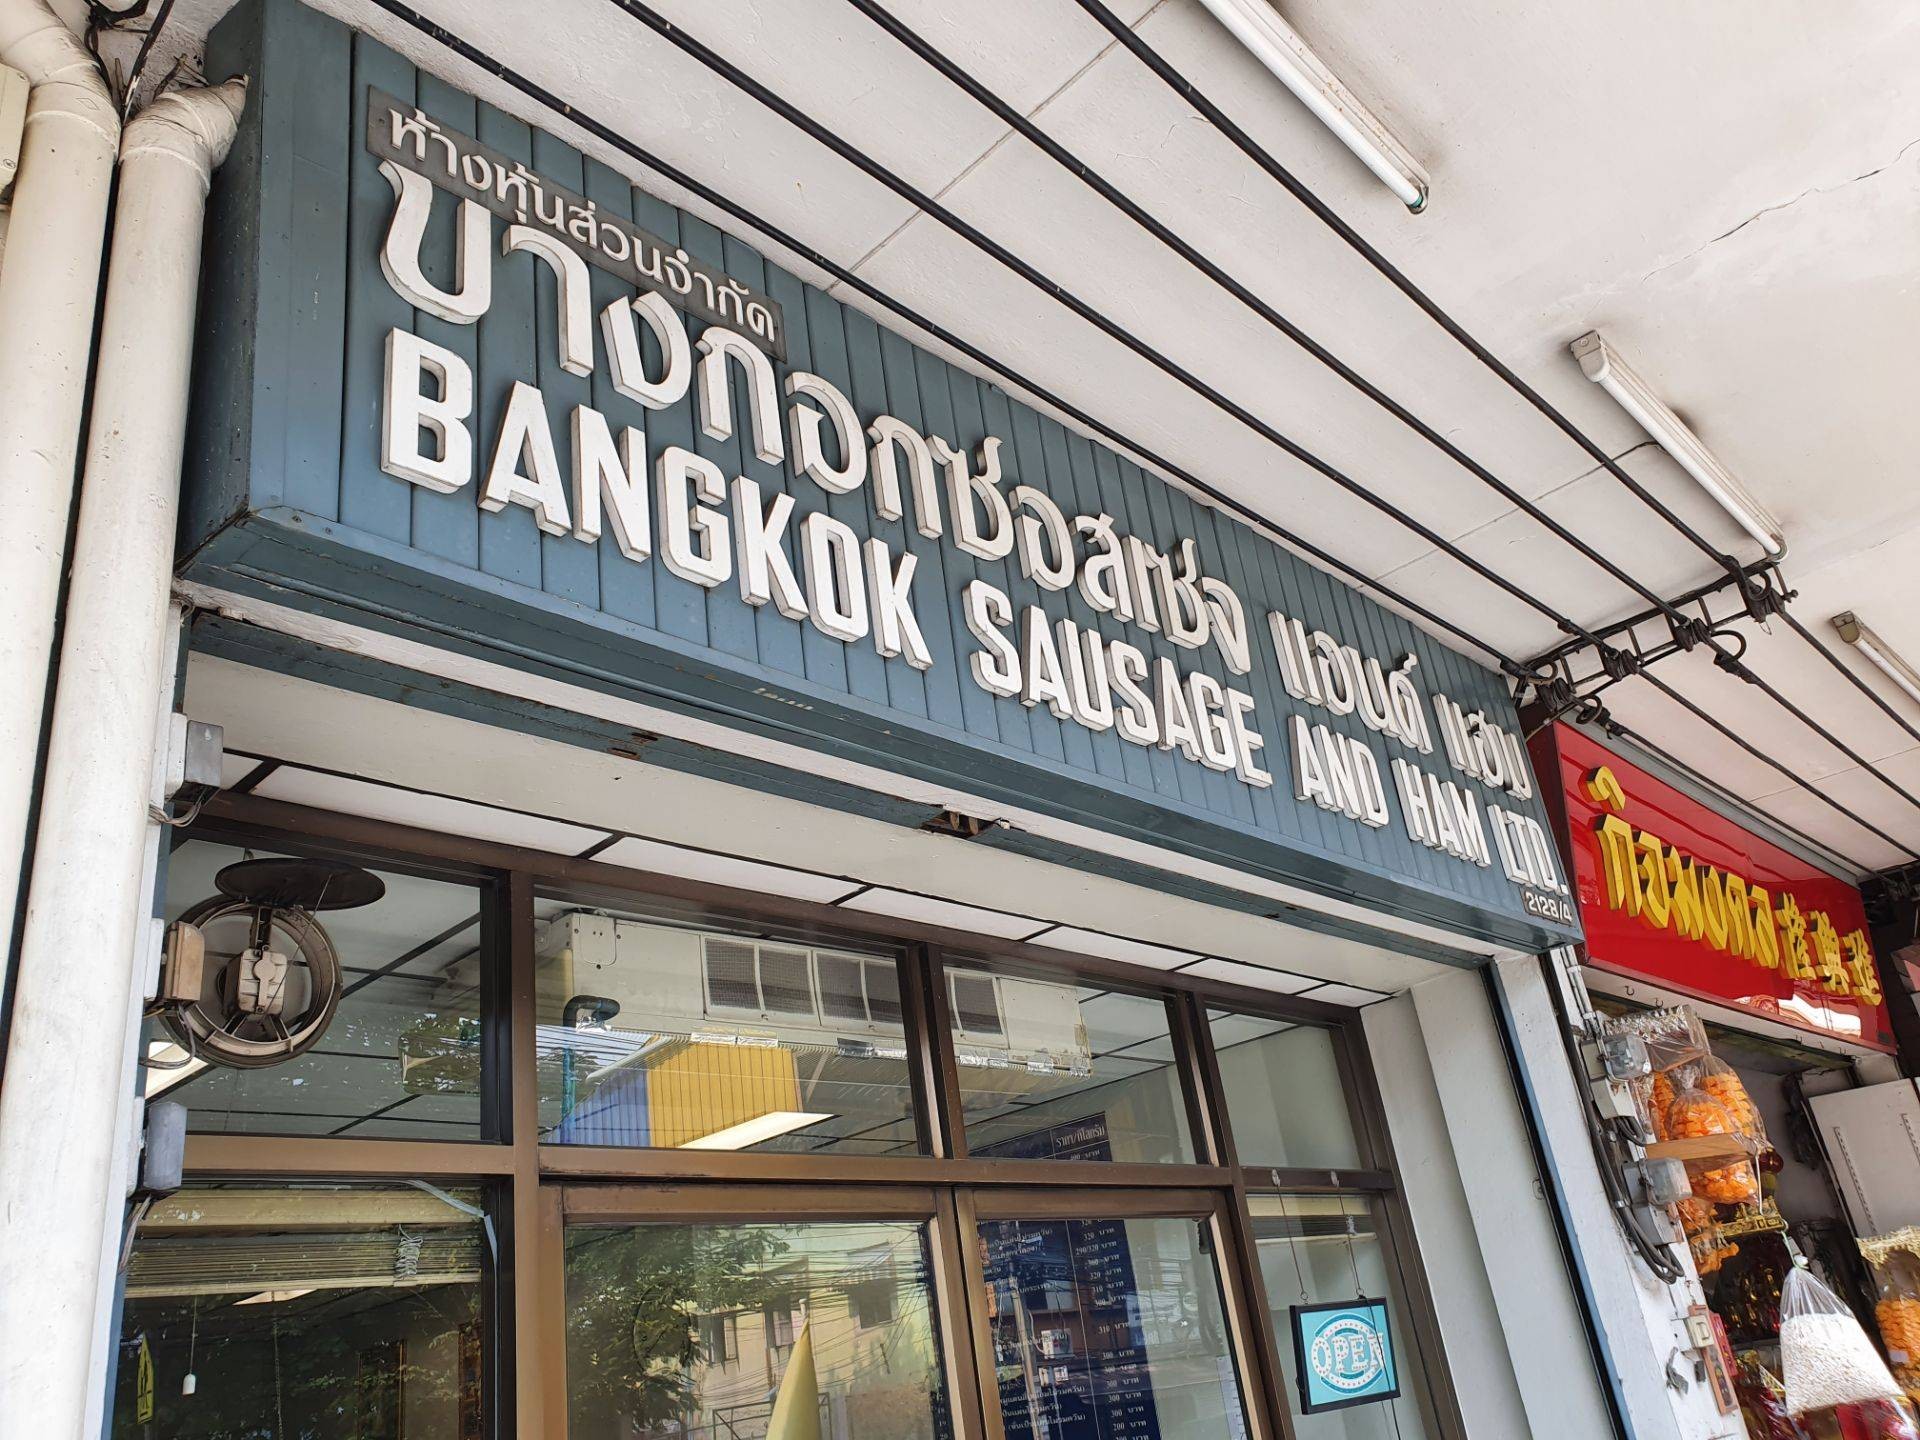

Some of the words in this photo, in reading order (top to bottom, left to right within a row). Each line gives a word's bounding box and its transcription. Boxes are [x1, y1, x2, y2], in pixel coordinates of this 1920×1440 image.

[388, 108, 776, 343] ห้างหุ้นส่วนจำกัด
[380, 328, 933, 670] BANGKOK
[961, 578, 1273, 789] SAUSAGE
[1287, 714, 1390, 828] AND
[1391, 756, 1491, 868] HAM
[1487, 803, 1570, 897] LTD.
[1267, 610, 1433, 755] แอนด์
[1433, 693, 1533, 801] แฮม
[1525, 893, 1573, 924] 2128/4
[1311, 1332, 1385, 1377] OPEN
